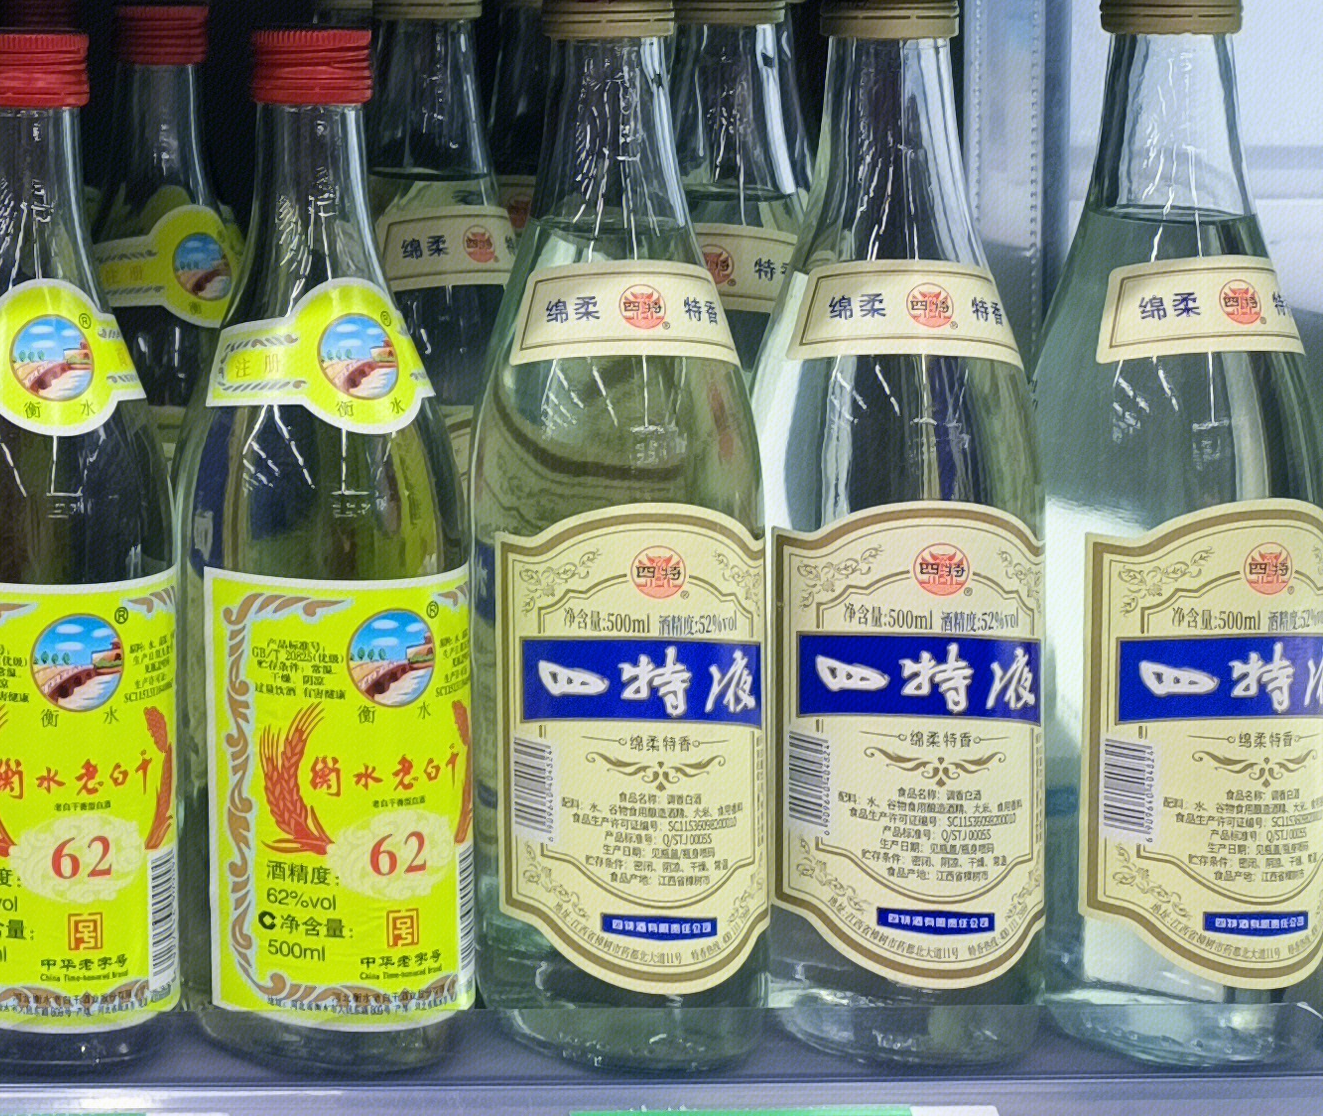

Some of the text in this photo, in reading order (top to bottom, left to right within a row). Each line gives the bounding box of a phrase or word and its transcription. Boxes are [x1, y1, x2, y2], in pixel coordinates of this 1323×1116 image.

[544, 291, 720, 327] 绵柔 特香
[827, 290, 888, 322] 绵柔
[1137, 290, 1202, 321] 绵柔
[635, 563, 682, 582] 四特
[919, 561, 966, 579] 四特
[1248, 561, 1290, 578] 四特
[563, 607, 651, 635] 净含量:500ml
[843, 602, 934, 631] 净含量:500ml
[1171, 606, 1262, 632] 净含量:500ml
[629, 734, 692, 753] 绵柔特香
[909, 729, 973, 749] 绵柔特香
[1238, 731, 1295, 749] 绵柔特香
[51, 835, 114, 880] 62
[369, 830, 428, 876] 62
[266, 887, 337, 912] 62%vol
[40, 953, 129, 971] 中华老字号
[267, 938, 326, 962] 500ml
